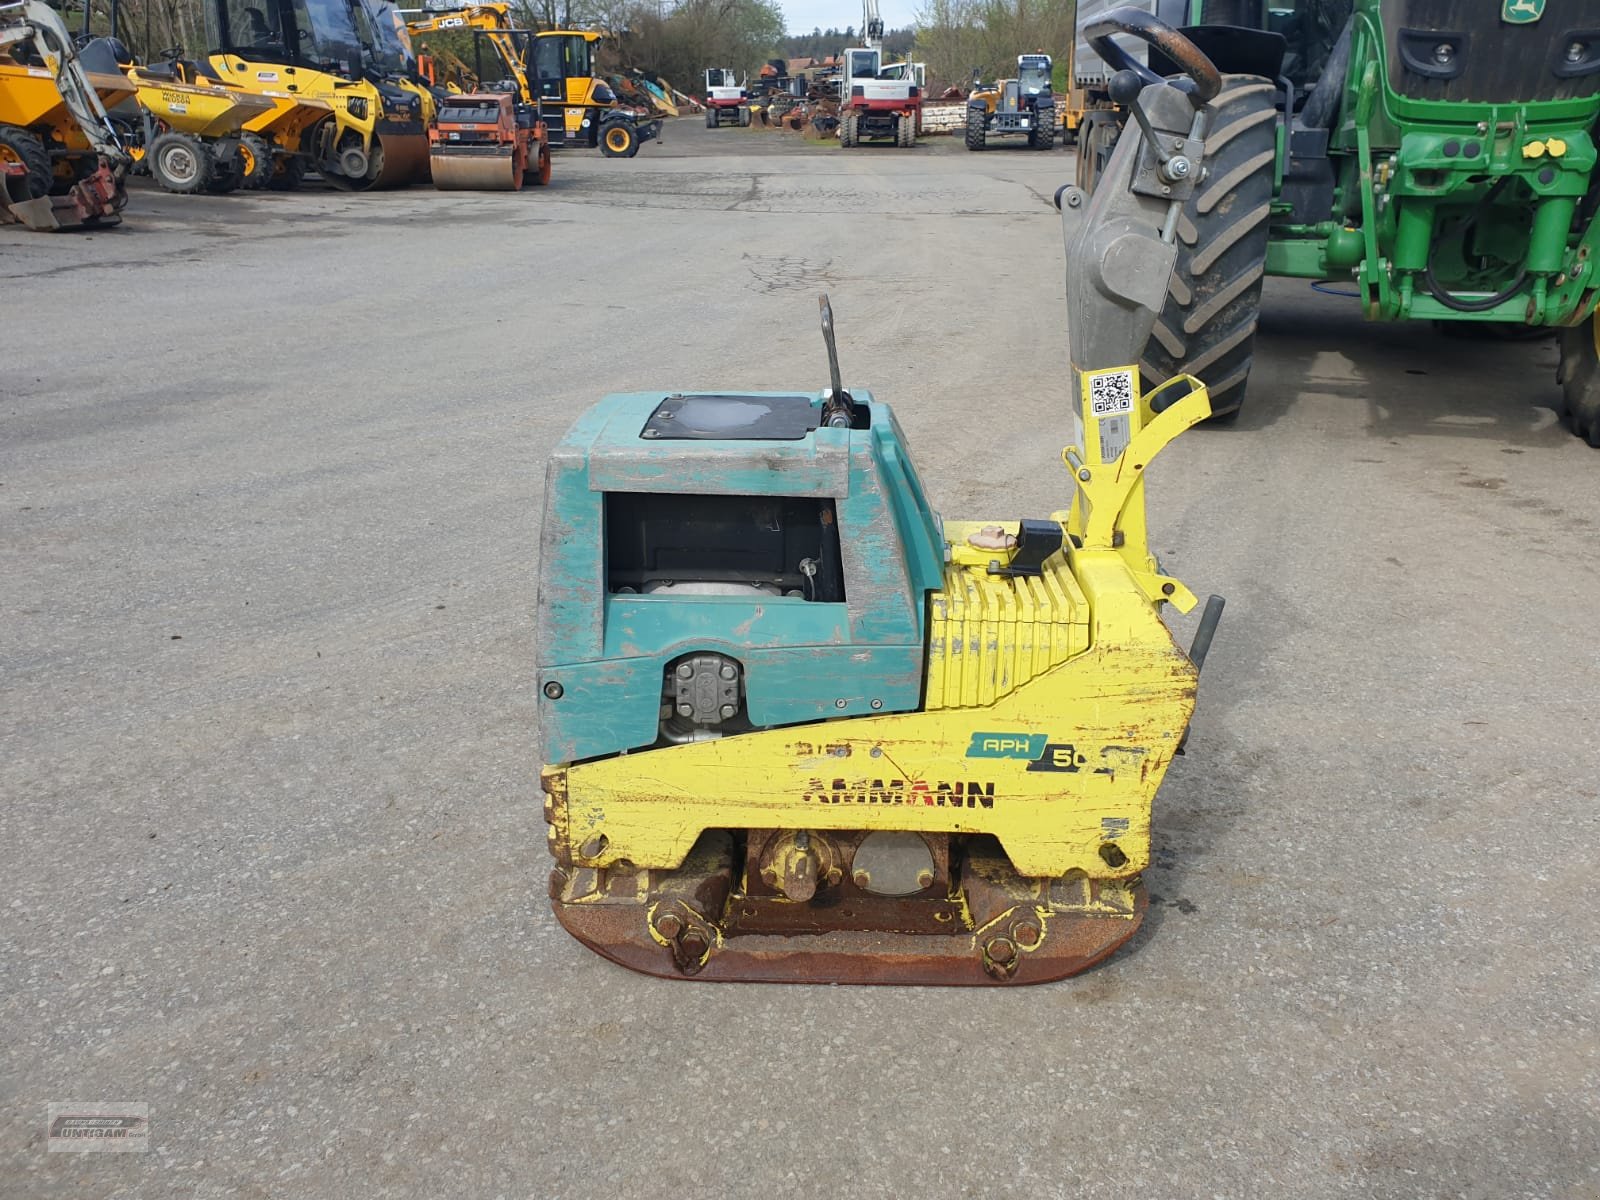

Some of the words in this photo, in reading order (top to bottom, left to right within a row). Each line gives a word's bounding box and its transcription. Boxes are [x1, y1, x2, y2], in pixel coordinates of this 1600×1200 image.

[438, 17, 463, 28] JCB
[983, 738, 1030, 752] APH
[802, 777, 995, 808] AMMANN
